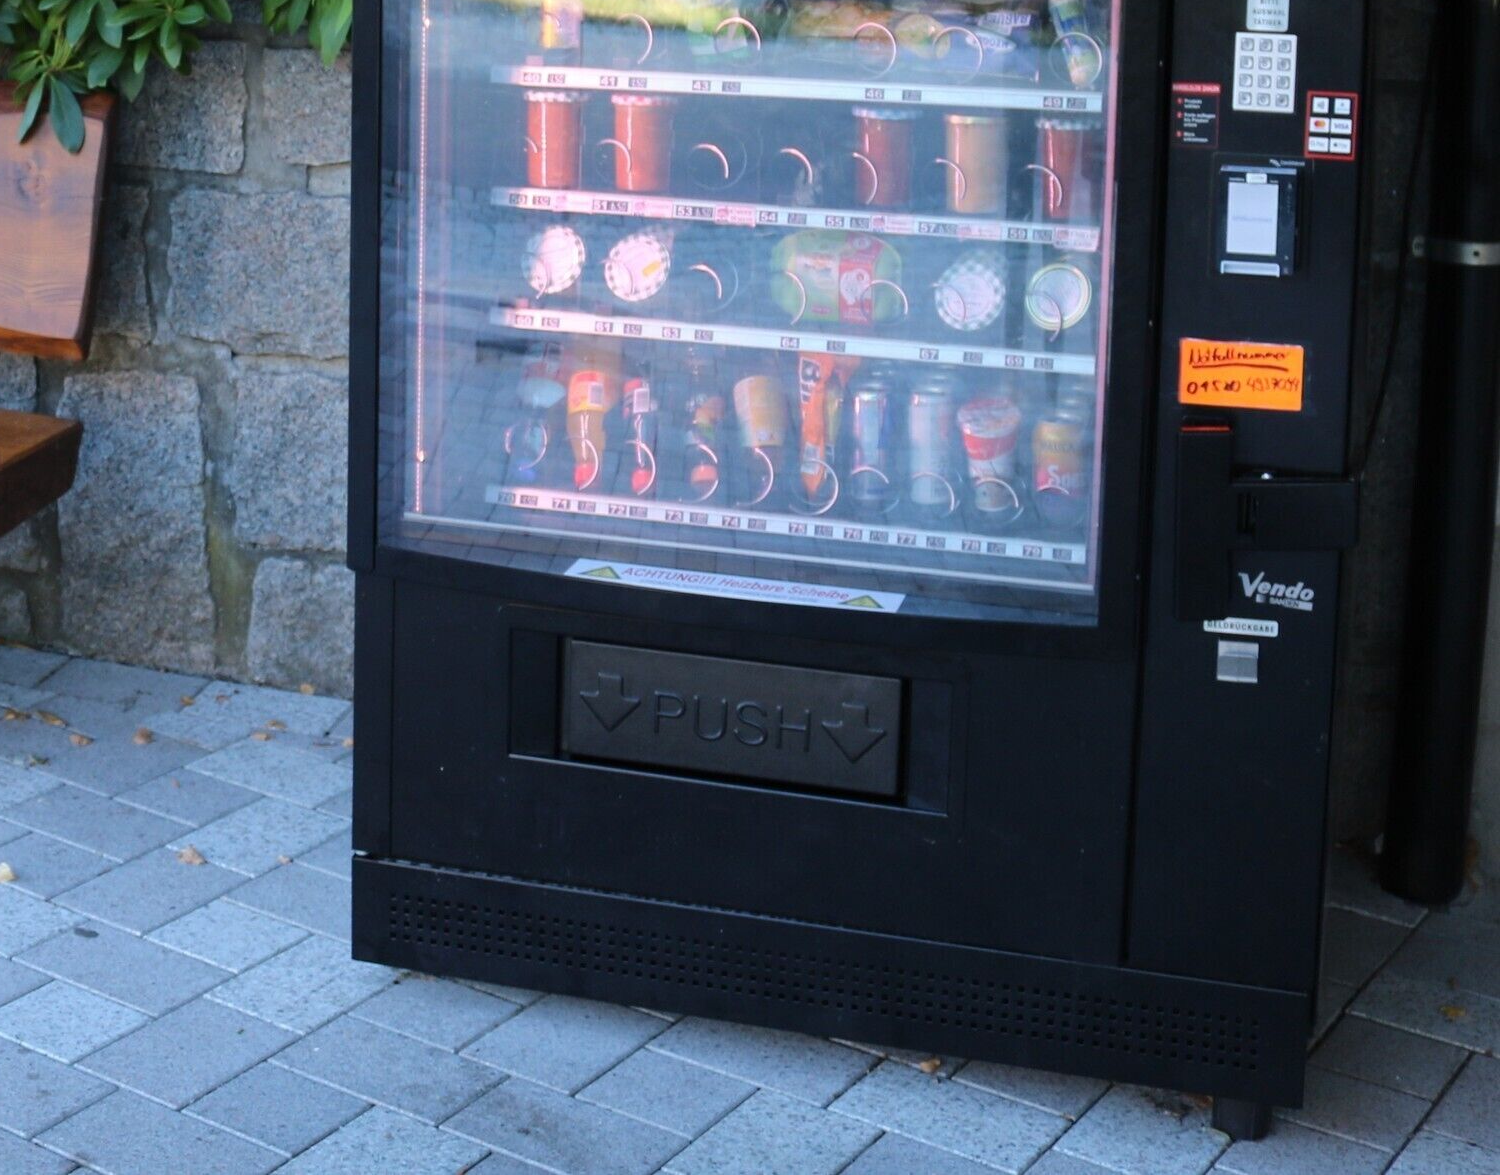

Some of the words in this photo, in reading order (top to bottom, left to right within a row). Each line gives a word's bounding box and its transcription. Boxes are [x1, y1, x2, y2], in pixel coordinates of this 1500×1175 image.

[1252, 8, 1286, 16] AUSWAHL
[601, 76, 617, 86] 41
[1044, 97, 1062, 107] 49
[677, 206, 693, 217] 53
[760, 211, 777, 222] 54
[827, 217, 843, 227] 55
[919, 222, 935, 233] 57
[1009, 228, 1026, 239] 59
[920, 349, 938, 359] 67
[1006, 356, 1023, 366] 69
[553, 498, 570, 508] 71
[610, 504, 626, 514] 72
[666, 510, 683, 520] 73
[722, 516, 740, 527] 74
[897, 533, 915, 544] 77
[962, 539, 980, 551] 78
[1023, 545, 1041, 556] 79
[621, 566, 716, 585] ACHTUNG!!!
[718, 577, 786, 594] Heizbare
[787, 582, 850, 601] Scheibe
[1238, 571, 1315, 601] Vendo
[1207, 620, 1274, 634] GELDRÜCKGABE
[653, 689, 811, 753] PUSH
